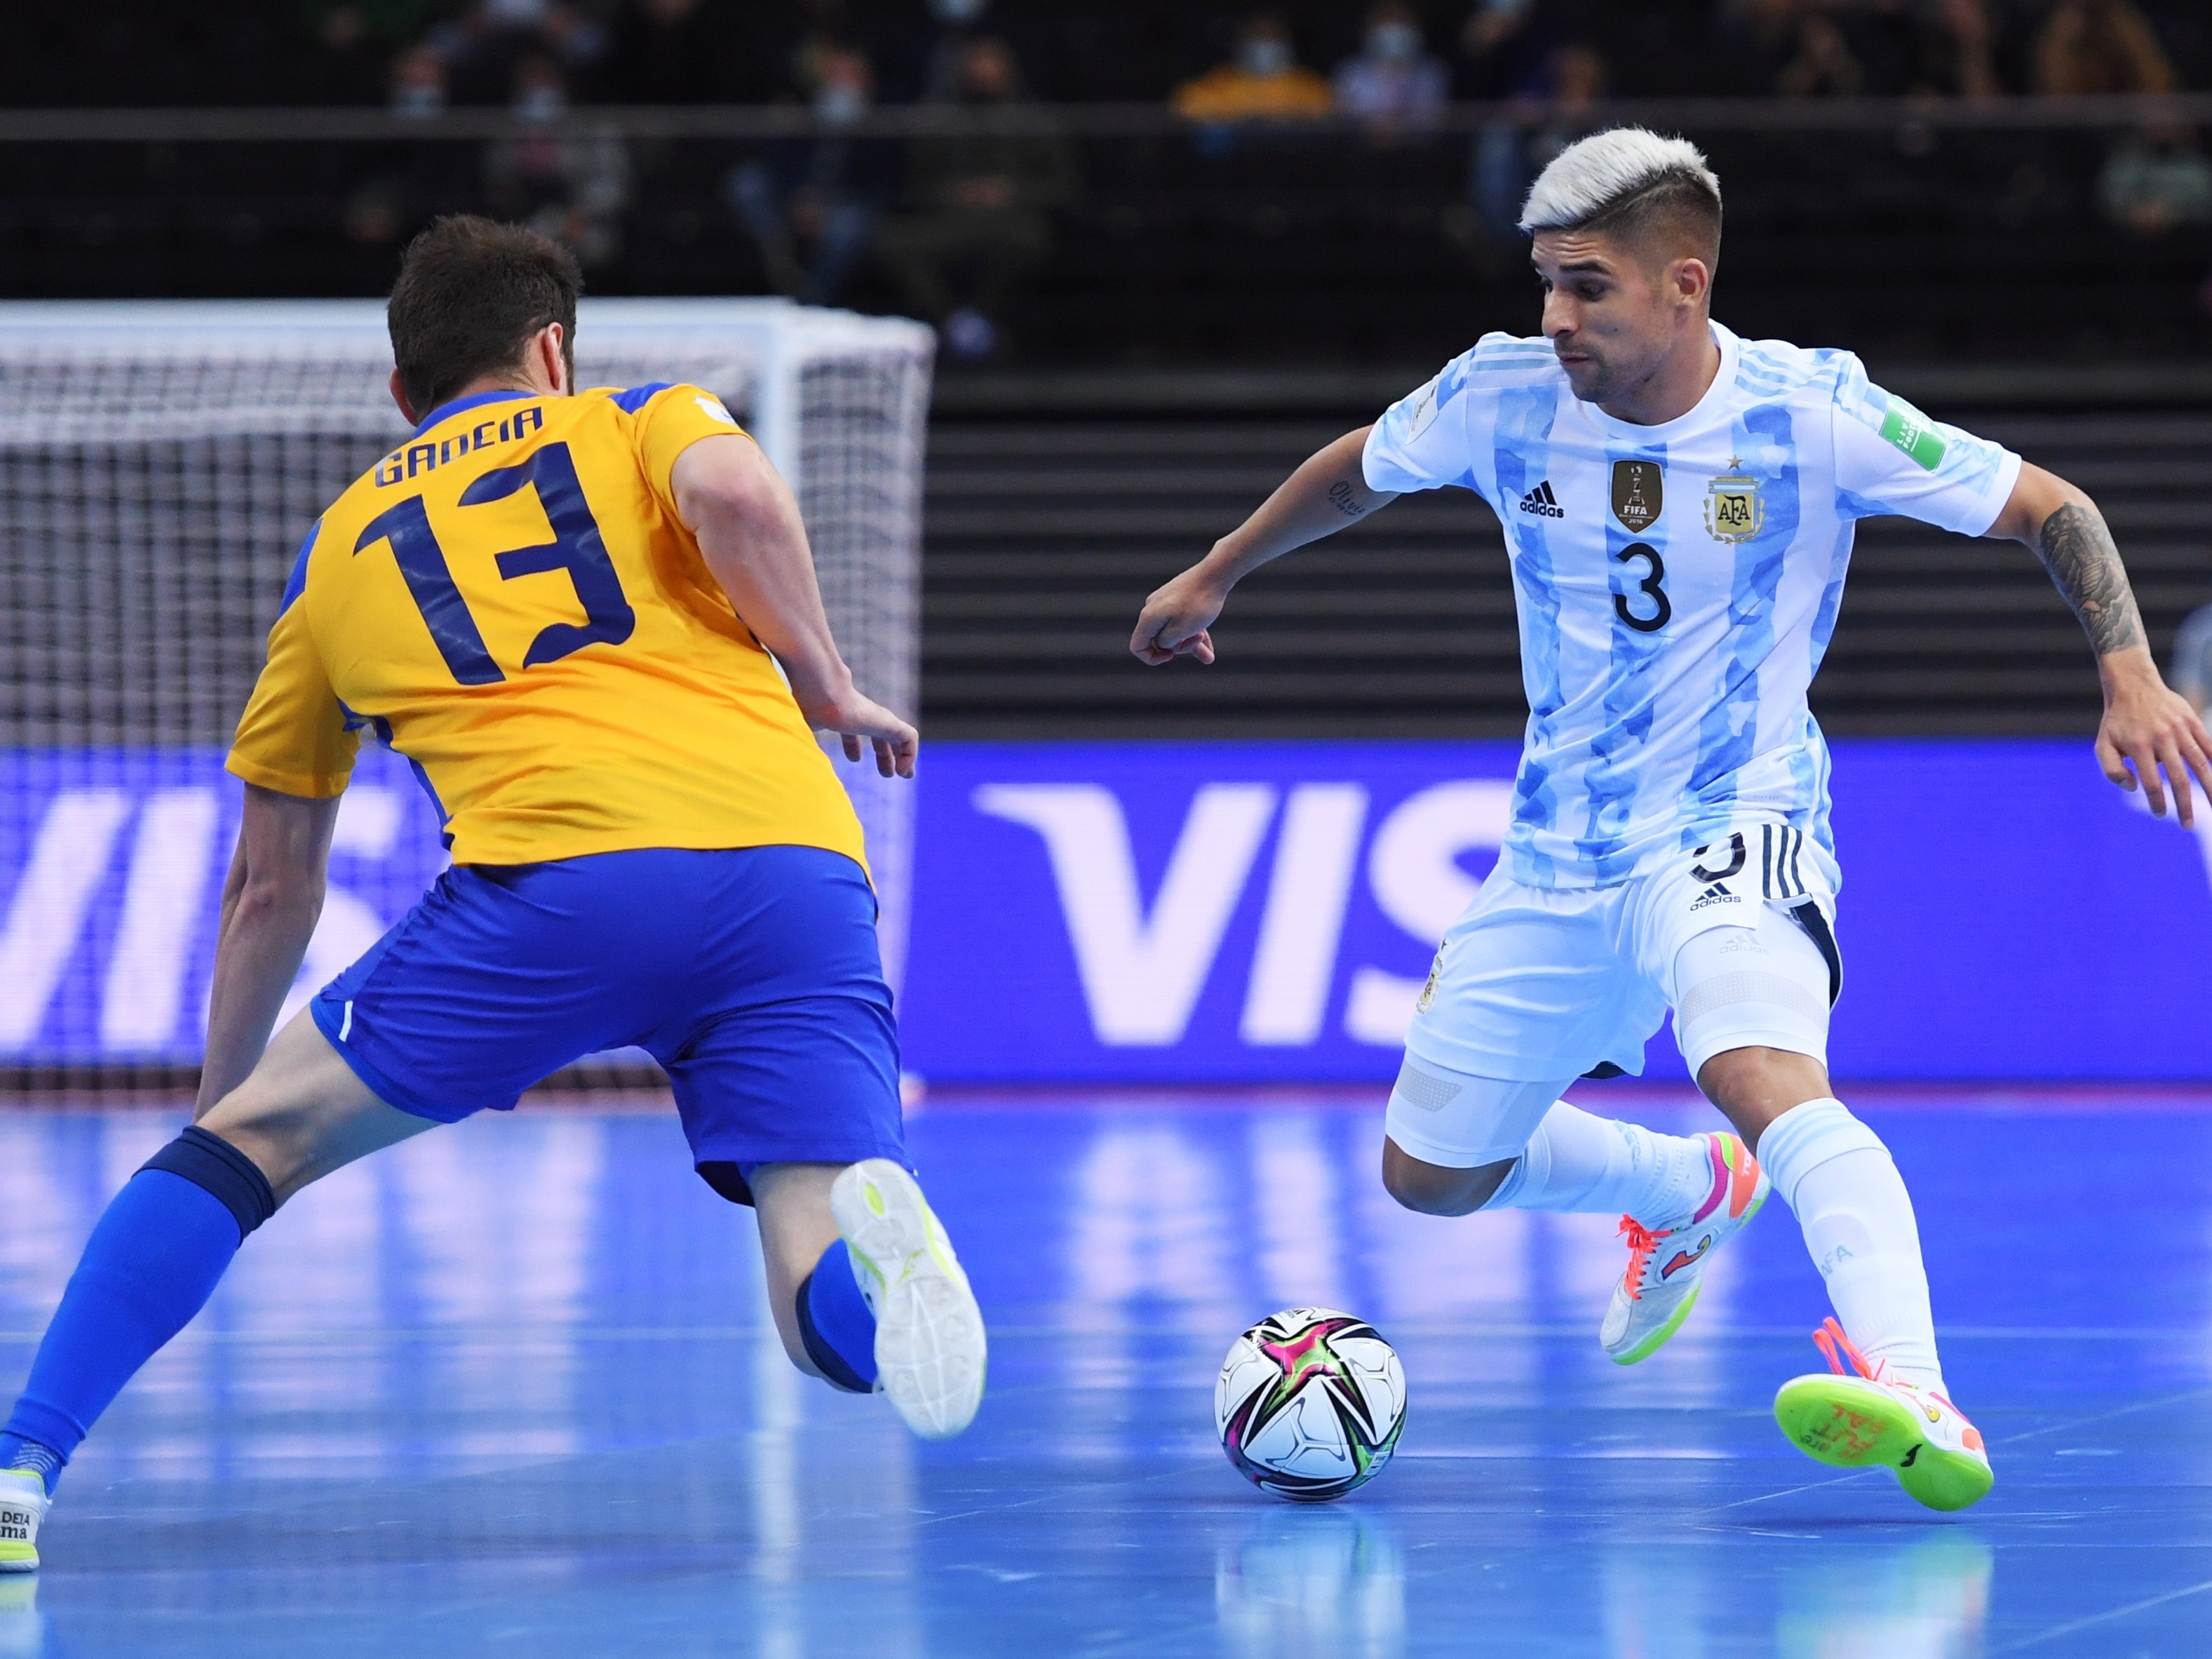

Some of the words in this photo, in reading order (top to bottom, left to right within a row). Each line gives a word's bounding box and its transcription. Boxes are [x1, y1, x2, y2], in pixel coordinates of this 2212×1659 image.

[1520, 499, 1564, 518] adidas
[1624, 505, 1647, 515] FIFA
[1718, 494, 1751, 526] AFA
[353, 441, 635, 685] 13
[1615, 542, 1671, 632] 3
[1690, 894, 1742, 911] adidas
[973, 780, 1515, 1047] VIS
[1719, 941, 1770, 955] adidas
[0, 1511, 30, 1526] DEIA
[0, 1525, 27, 1540] ma
